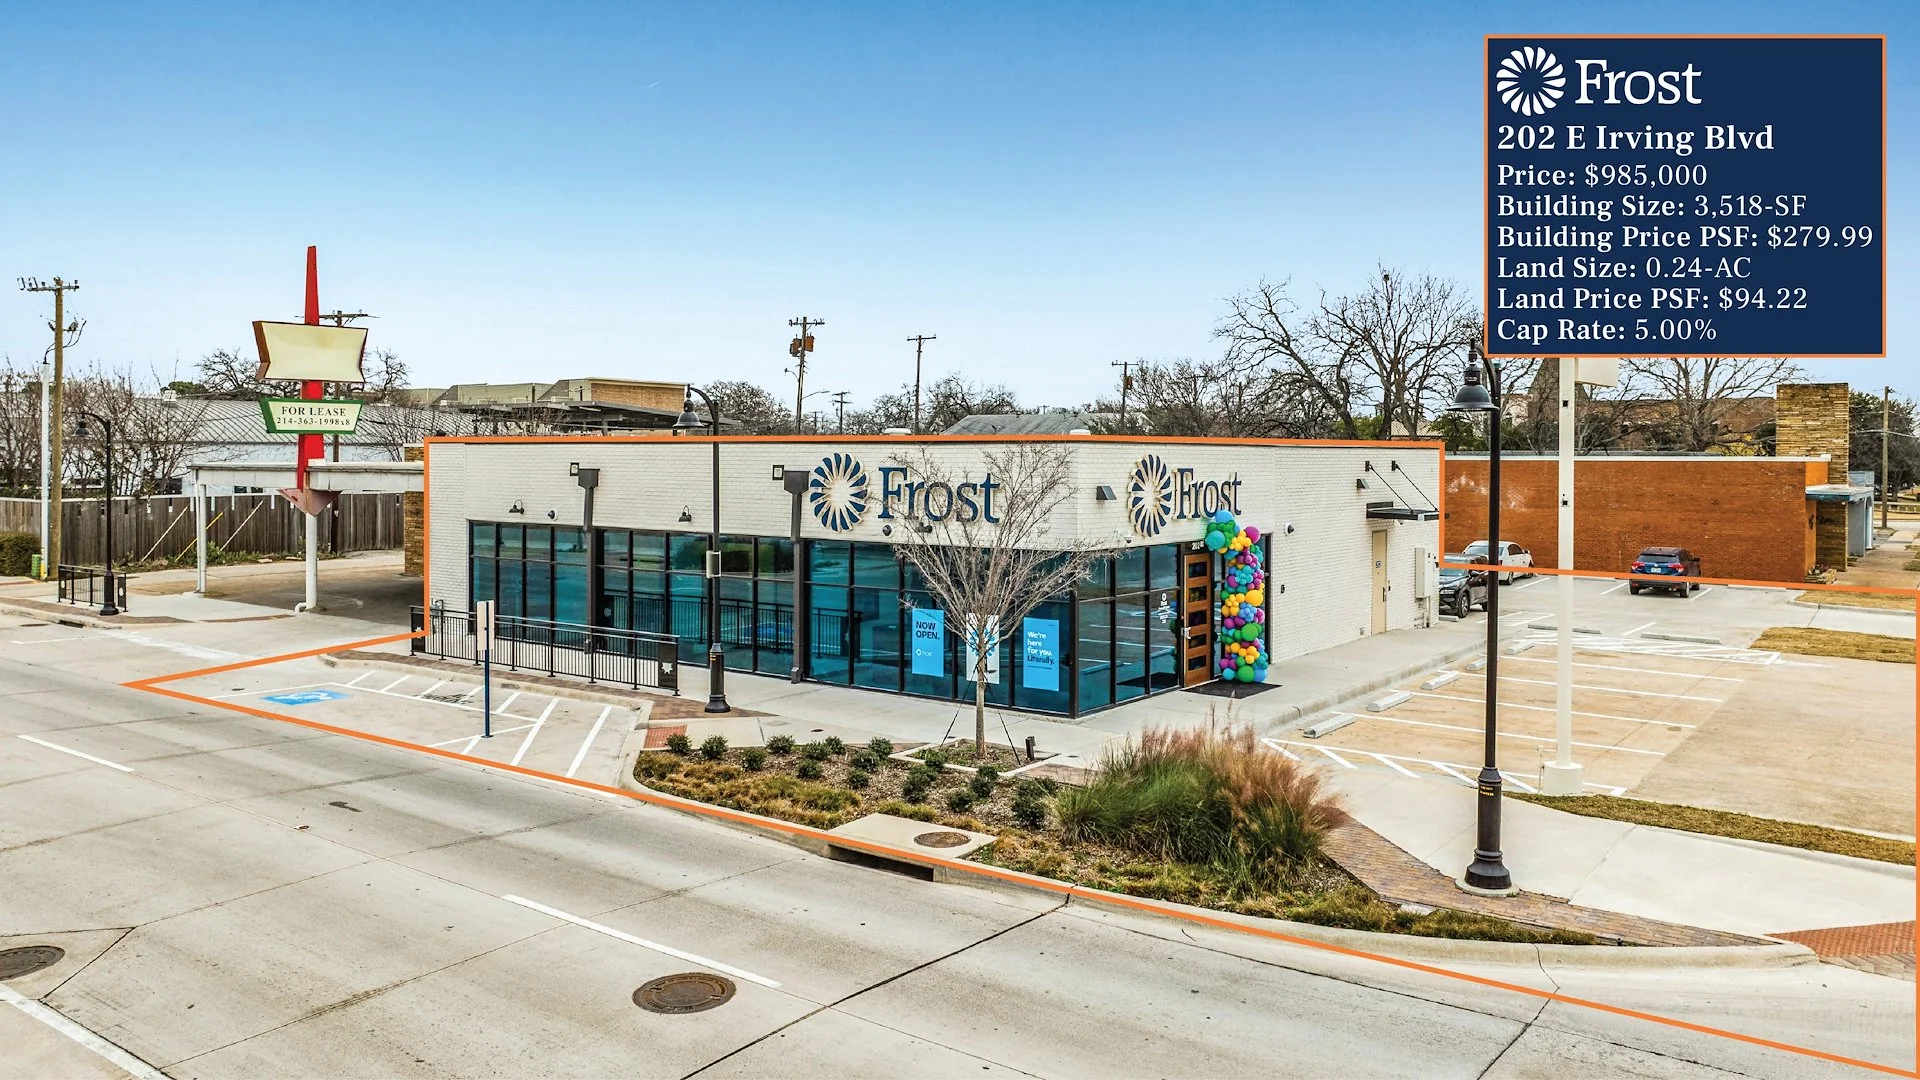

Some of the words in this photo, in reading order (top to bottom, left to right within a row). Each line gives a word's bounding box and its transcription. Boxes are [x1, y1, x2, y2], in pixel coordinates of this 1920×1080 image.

[281, 406, 306, 416] FOR
[309, 407, 347, 417] LEASE
[878, 467, 1001, 524] Frost
[1175, 467, 1242, 520] Frost
[915, 621, 936, 631] NOW
[915, 630, 940, 640] OPEN.
[1027, 631, 1047, 640] We're
[1027, 638, 1043, 647] here
[1027, 645, 1039, 654] for
[1027, 655, 1055, 666] Literally.
